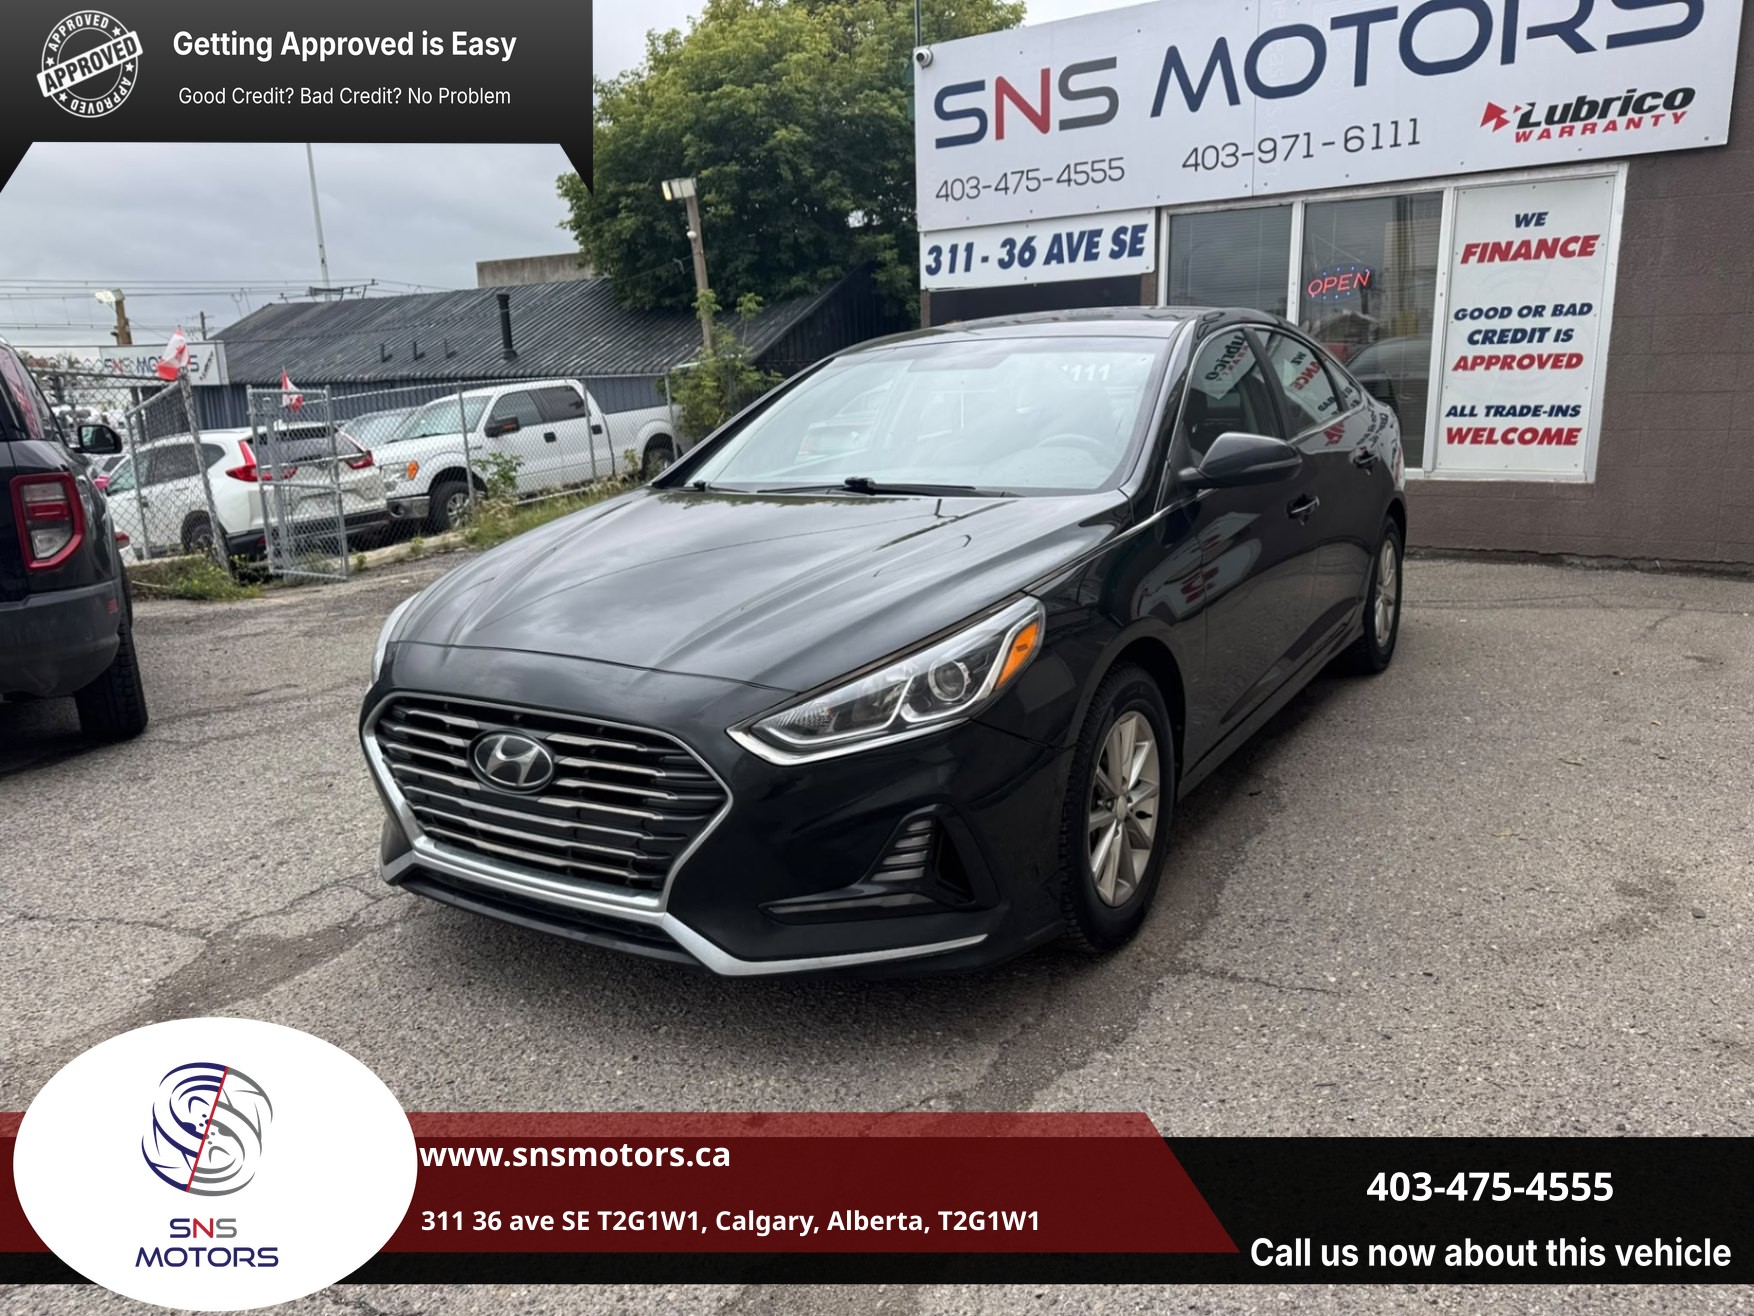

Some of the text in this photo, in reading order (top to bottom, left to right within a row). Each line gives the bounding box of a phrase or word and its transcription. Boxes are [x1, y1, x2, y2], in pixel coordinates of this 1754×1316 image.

[934, 0, 1705, 149] SNS MOTORS
[1516, 87, 1696, 130] Lubrico
[1515, 111, 1688, 143] WARRANTY
[1182, 118, 1421, 172] 403-971-6111
[935, 157, 1126, 202] 403-475-4555
[1514, 211, 1549, 229] WE
[925, 243, 974, 276] 311
[997, 236, 1037, 270] 36
[1043, 229, 1104, 266] AVE
[1109, 224, 1149, 260] SE
[1460, 235, 1601, 265] FINANCE
[1307, 271, 1371, 297] OPEN
[1453, 302, 1594, 321] GOOD OR BAD
[1467, 326, 1575, 346] CREDIT IS
[1451, 352, 1584, 372] APPROVED
[1445, 404, 1582, 418] ALL TRADE-INS
[1446, 427, 1583, 446] WELCOME
